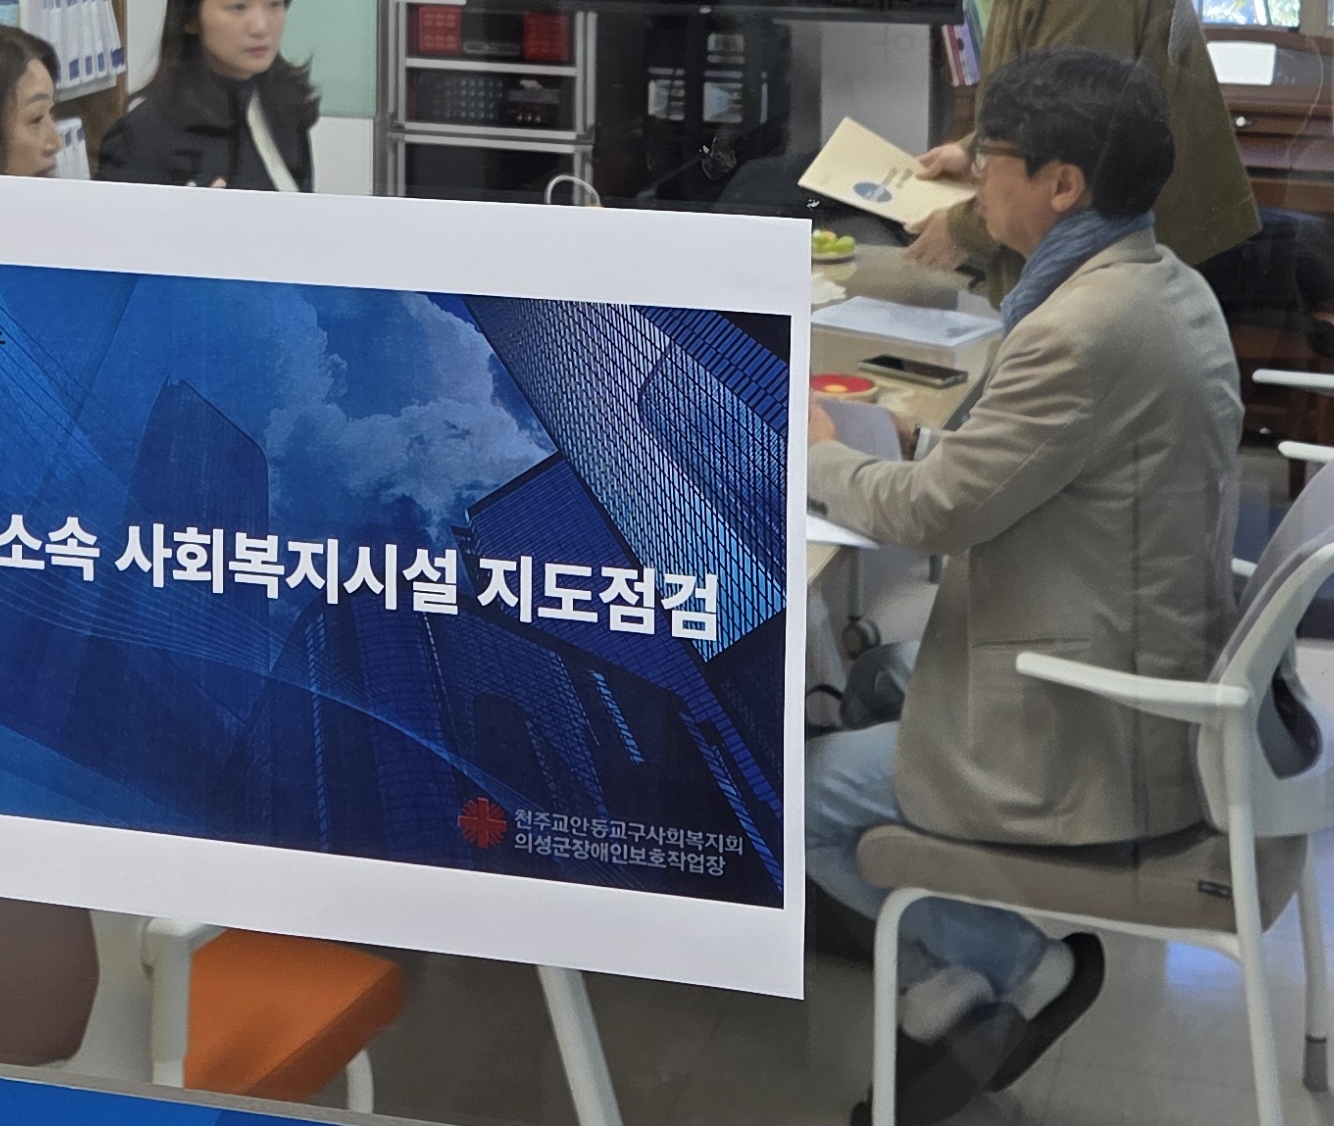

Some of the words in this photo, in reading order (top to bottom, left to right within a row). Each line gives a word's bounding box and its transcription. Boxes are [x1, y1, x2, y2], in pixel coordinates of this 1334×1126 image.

[115, 521, 460, 616] 사회복지시설
[479, 555, 718, 641] 지도점검
[514, 808, 744, 856] 천주교안동교구사회복지회
[514, 832, 726, 877] 의성군장애인보호작업장
